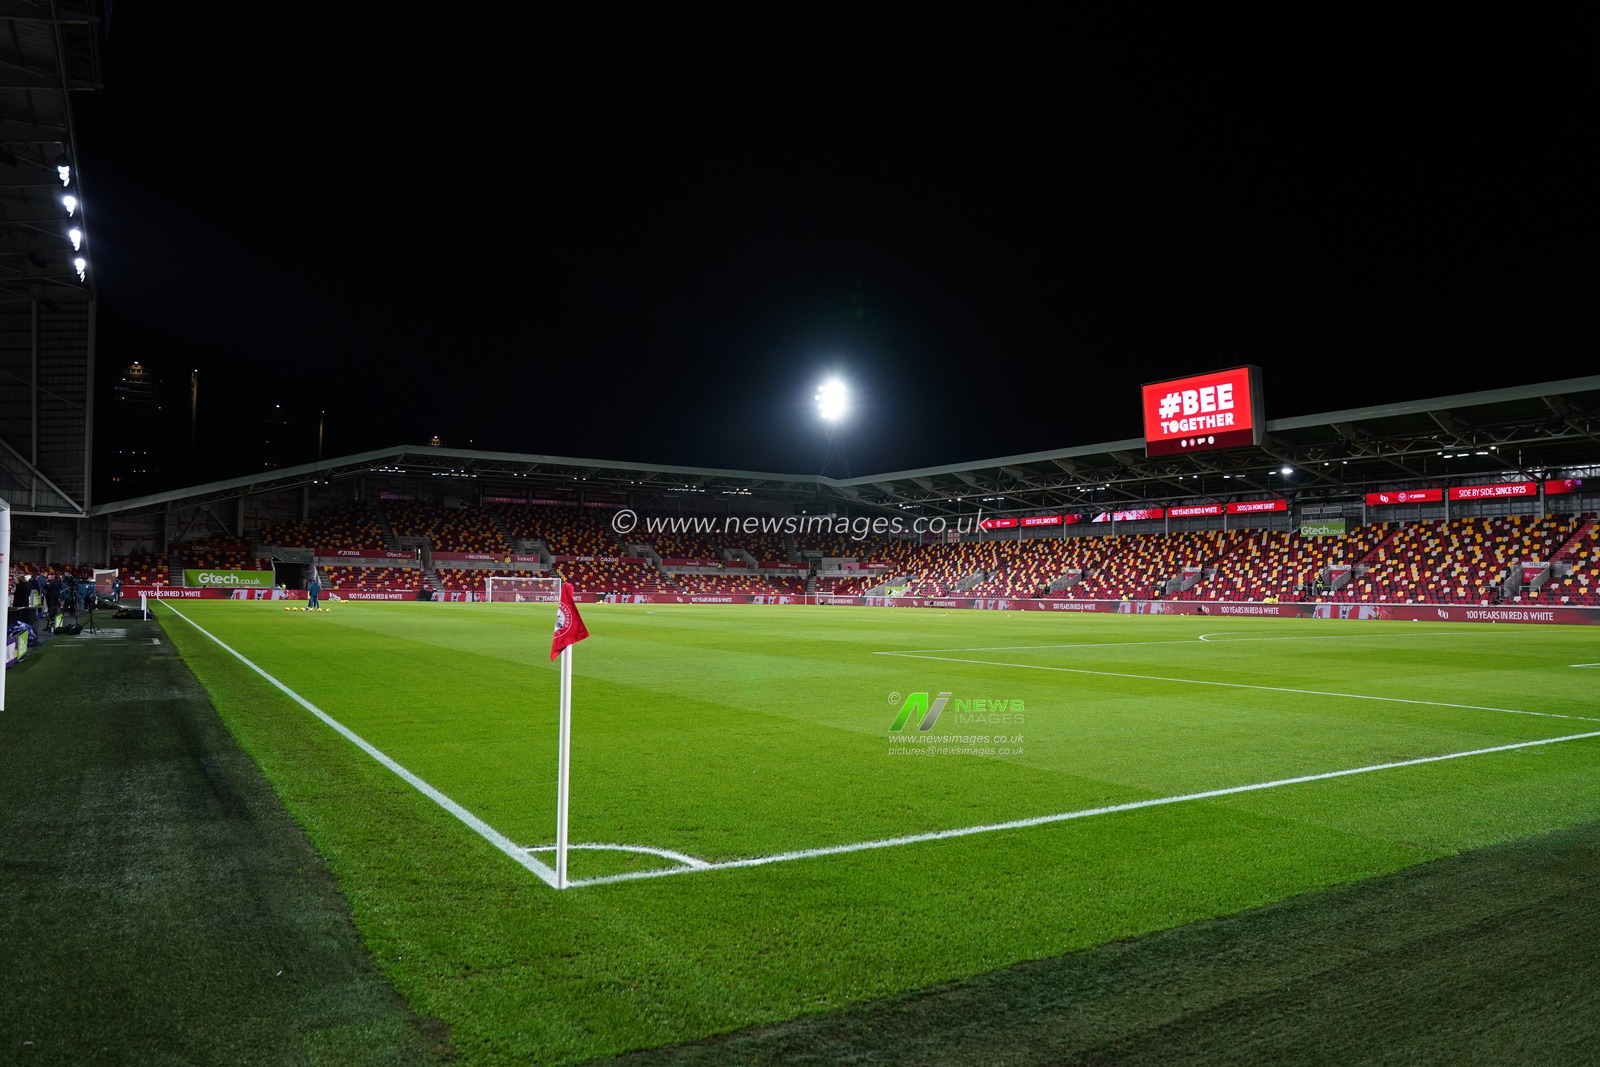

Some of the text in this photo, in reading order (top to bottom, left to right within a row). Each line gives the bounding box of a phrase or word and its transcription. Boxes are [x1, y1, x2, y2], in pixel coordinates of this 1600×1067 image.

[1158, 383, 1234, 419] #BEE
[1160, 412, 1234, 434] TOGETHER
[1458, 485, 1527, 498] SIDE BY SIDE, SINCE 1925
[1205, 506, 1218, 514] WHITE
[1253, 503, 1264, 511] HOME
[1263, 502, 1275, 510] SHIRT
[1300, 525, 1346, 535] Gtech.co.uk
[198, 572, 261, 585] Gtech.co.uk
[184, 590, 201, 598] WHITE
[1220, 606, 1279, 615] 100 YEARS IN RED & WHITE
[1465, 610, 1554, 621] 100 YEARS IN RED & WHITE
